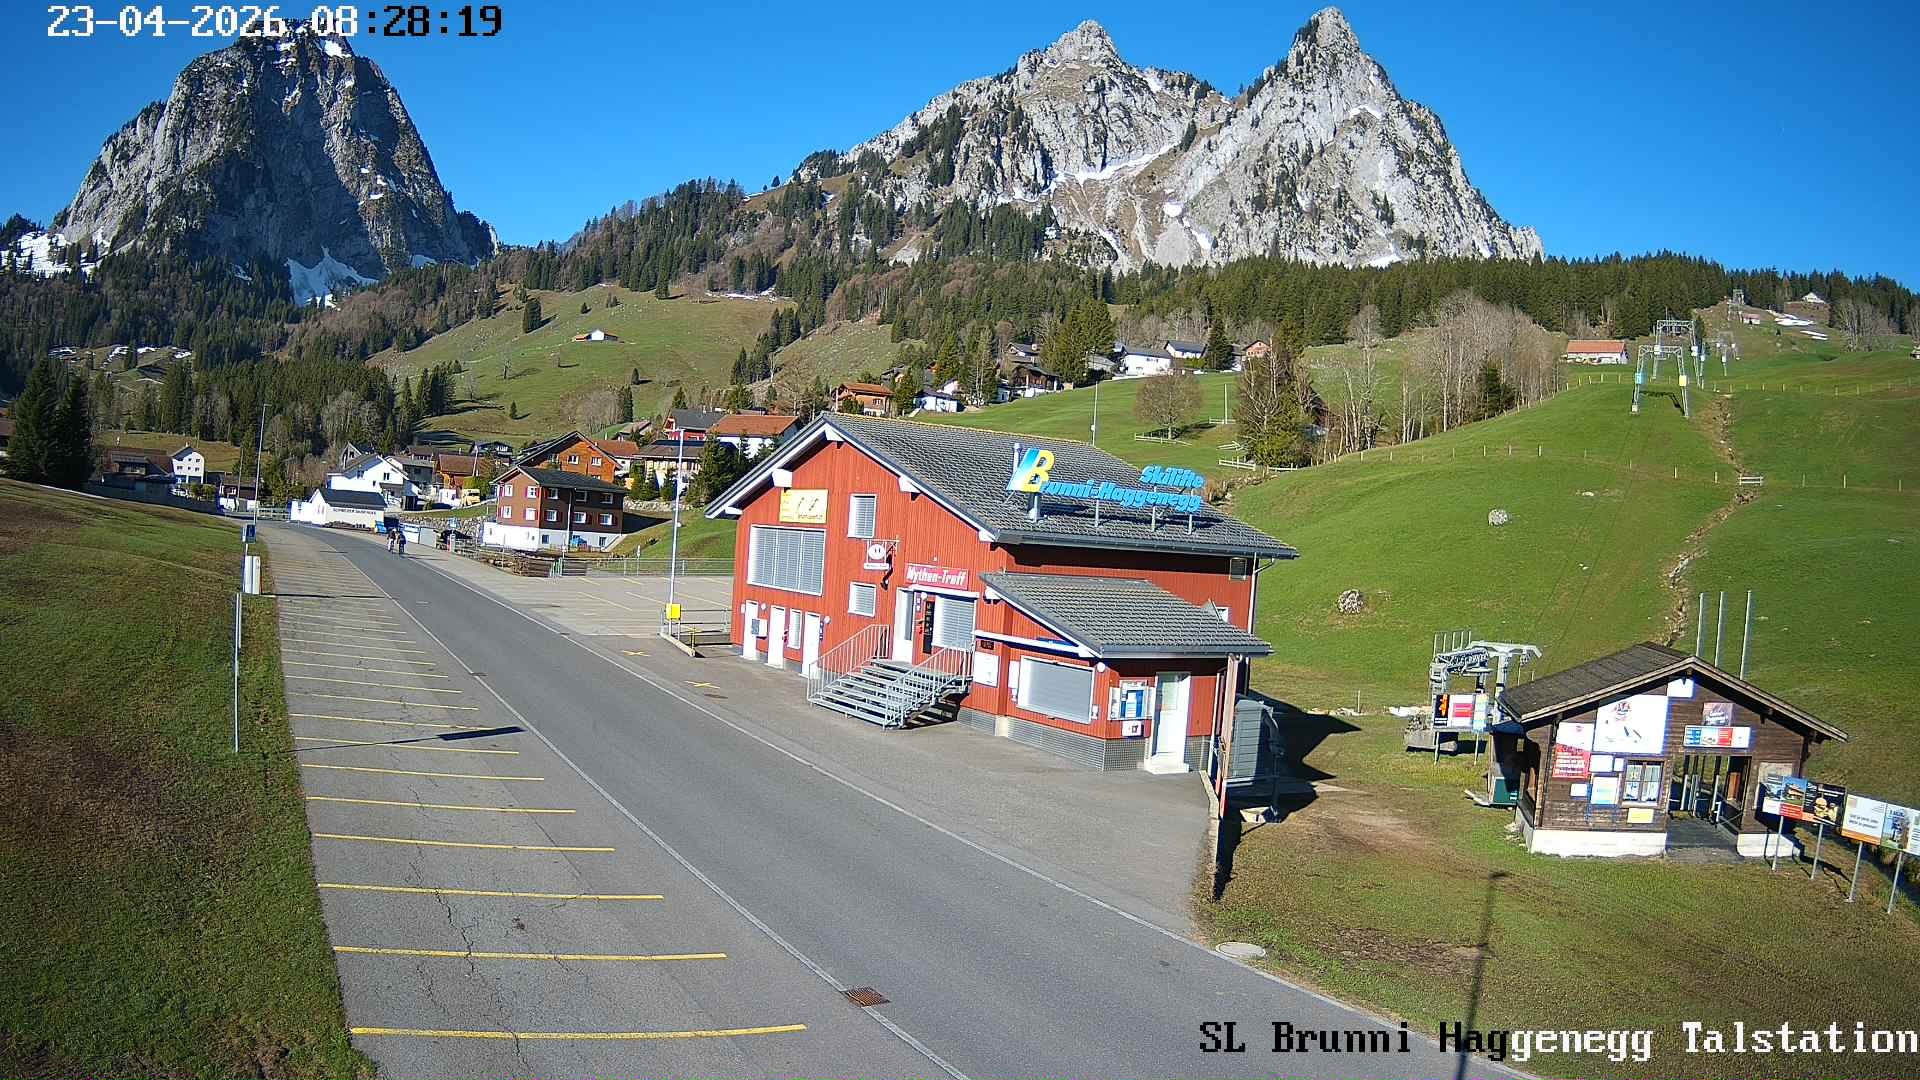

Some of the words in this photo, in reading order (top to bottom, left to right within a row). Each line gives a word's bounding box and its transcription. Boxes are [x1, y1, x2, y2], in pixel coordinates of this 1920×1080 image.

[1007, 448, 1202, 512] Brunni-Haggenegg
[1140, 464, 1205, 488] Skilifte
[906, 566, 967, 586] Mythen-Treff
